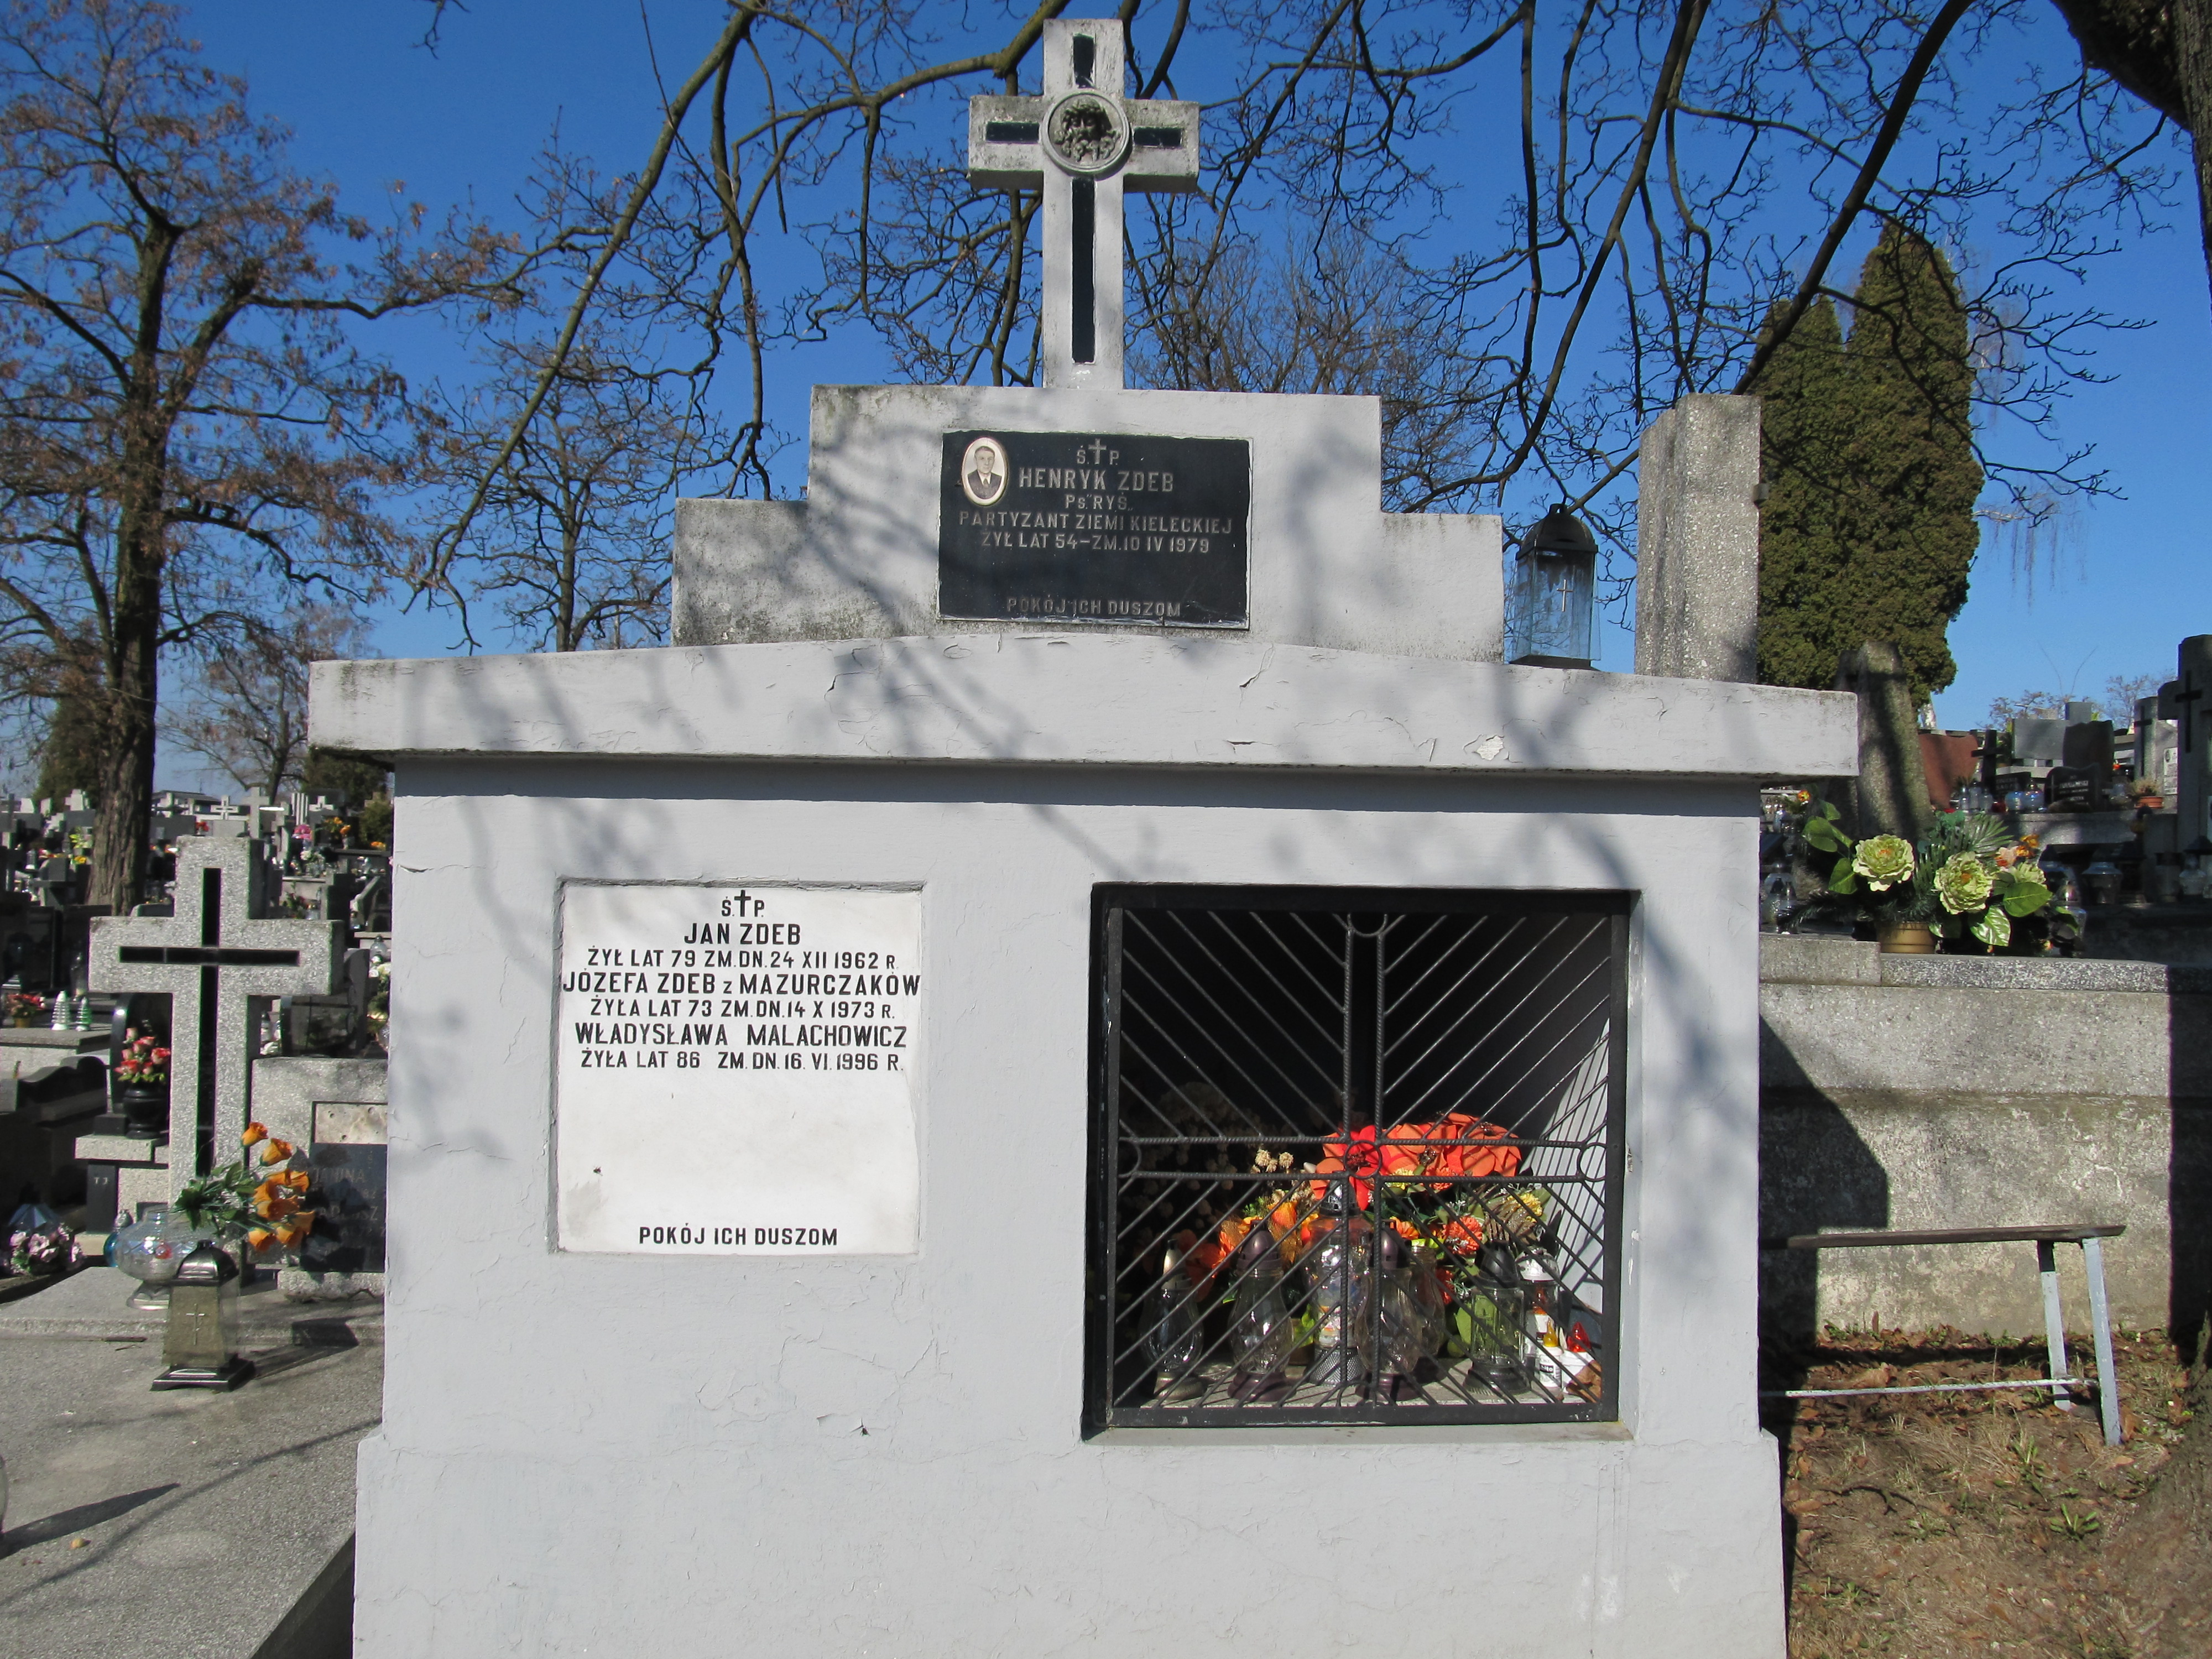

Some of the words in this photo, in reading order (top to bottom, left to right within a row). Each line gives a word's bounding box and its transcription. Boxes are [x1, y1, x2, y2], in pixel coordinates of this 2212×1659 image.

[1019, 467, 1106, 490] HENRYK
[1117, 470, 1174, 492] ZDEB
[959, 510, 1070, 529] PARTYZANT
[1075, 513, 1124, 530] ZIEMI
[1130, 515, 1232, 534] KIELECKIEJ
[1018, 532, 1050, 549] LAT
[1146, 535, 1163, 551] IV
[1170, 536, 1209, 553] 1979
[1006, 594, 1066, 613] POKÓJ
[1072, 598, 1102, 614] ICH
[1107, 600, 1181, 617] DUSZOM
[684, 923, 730, 945] JAN
[740, 924, 801, 945] ZDEB
[588, 945, 623, 966] ŻYŁ
[630, 949, 664, 967] LAT
[671, 950, 696, 967] 79
[802, 951, 827, 969] XII
[834, 951, 879, 969] 1962
[562, 968, 648, 993] JÓZEFA
[658, 973, 715, 994] ZDEB
[739, 972, 921, 995] MAZURCZAKÓW
[591, 994, 640, 1016] ŻYŁA
[648, 999, 681, 1017] LAT
[688, 1000, 712, 1017] 73
[812, 1000, 823, 1019] X
[831, 1001, 875, 1019] 1973
[575, 1022, 728, 1046] WŁADYSŁAWA
[747, 1024, 907, 1048] MALACHOWICZ
[581, 1047, 628, 1068] ŻYŁA
[637, 1051, 669, 1068] LAT
[676, 1051, 701, 1068] 86
[639, 1223, 705, 1244] POKÓJ
[713, 1227, 746, 1245] ICH
[754, 1228, 838, 1245] DUSZOM
